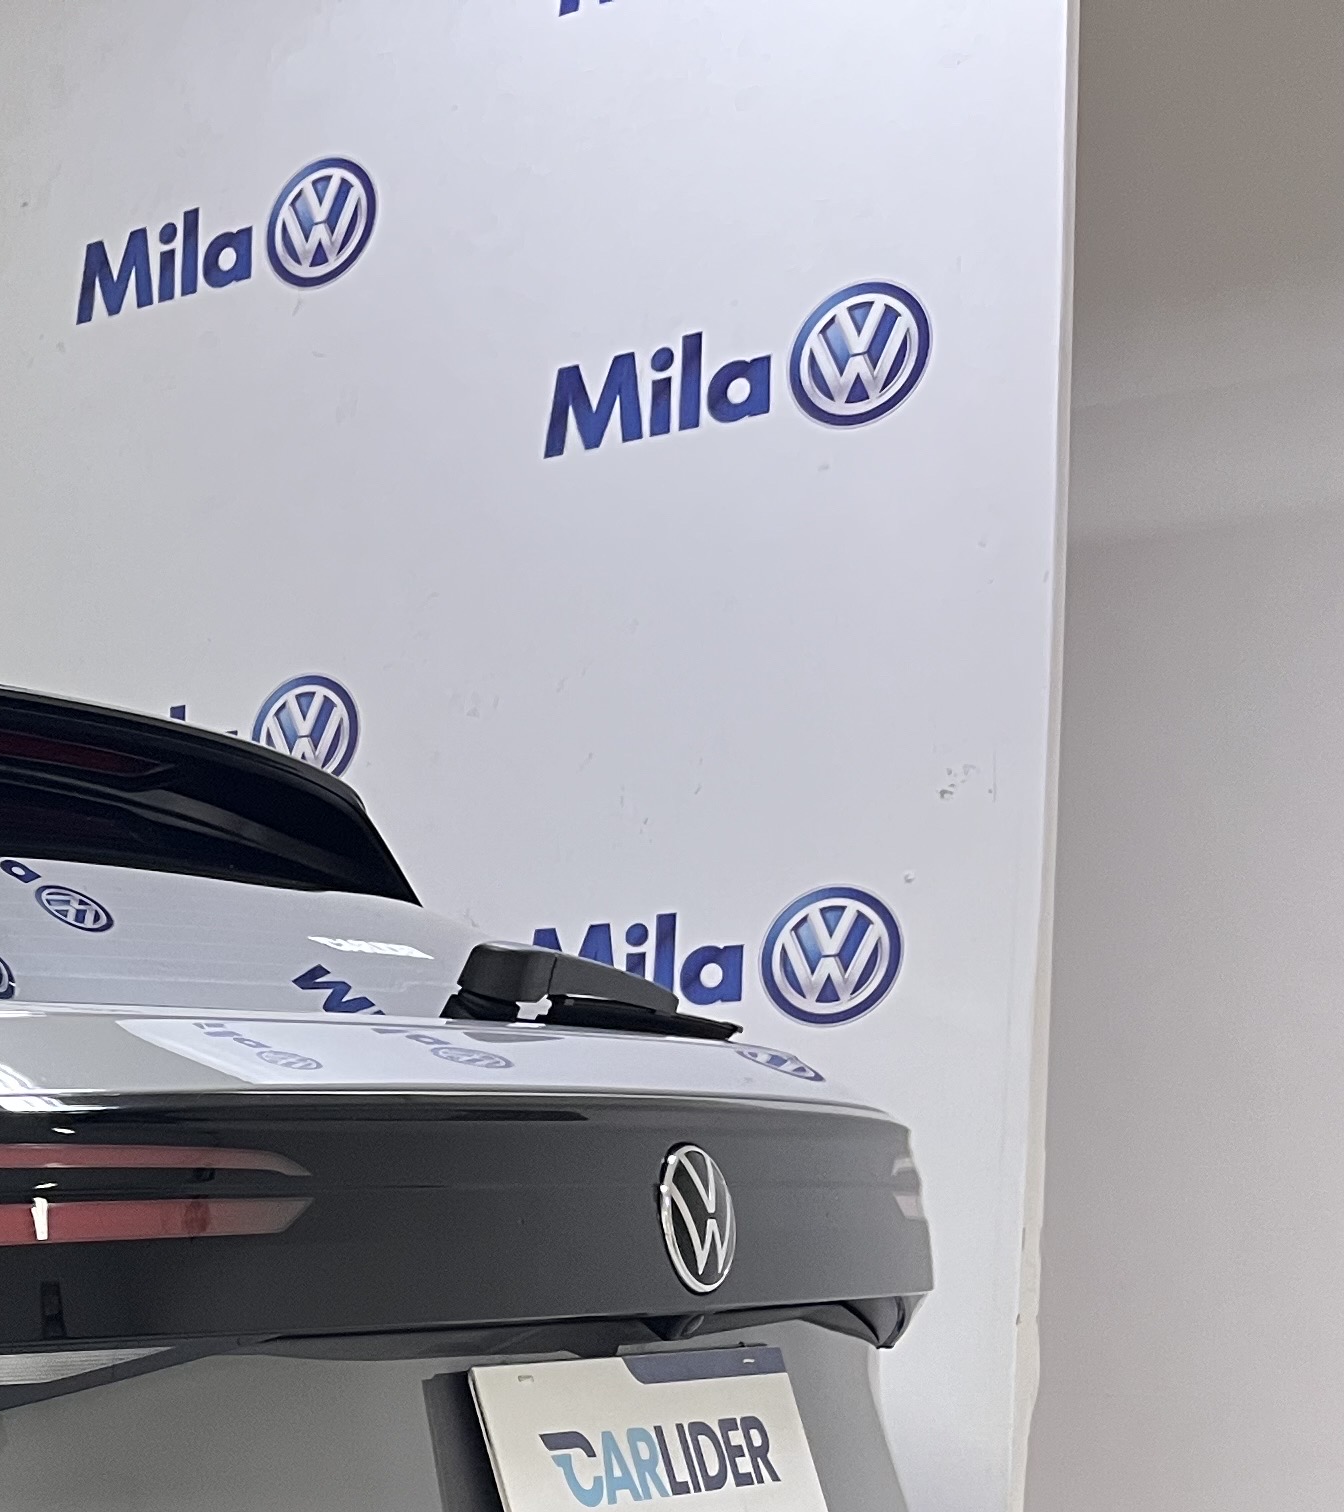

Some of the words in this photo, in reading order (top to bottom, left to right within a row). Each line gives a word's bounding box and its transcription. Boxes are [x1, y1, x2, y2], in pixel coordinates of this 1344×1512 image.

[75, 206, 253, 326] Mila
[543, 331, 772, 460] Mila
[538, 1414, 781, 1508] CARLIDER
